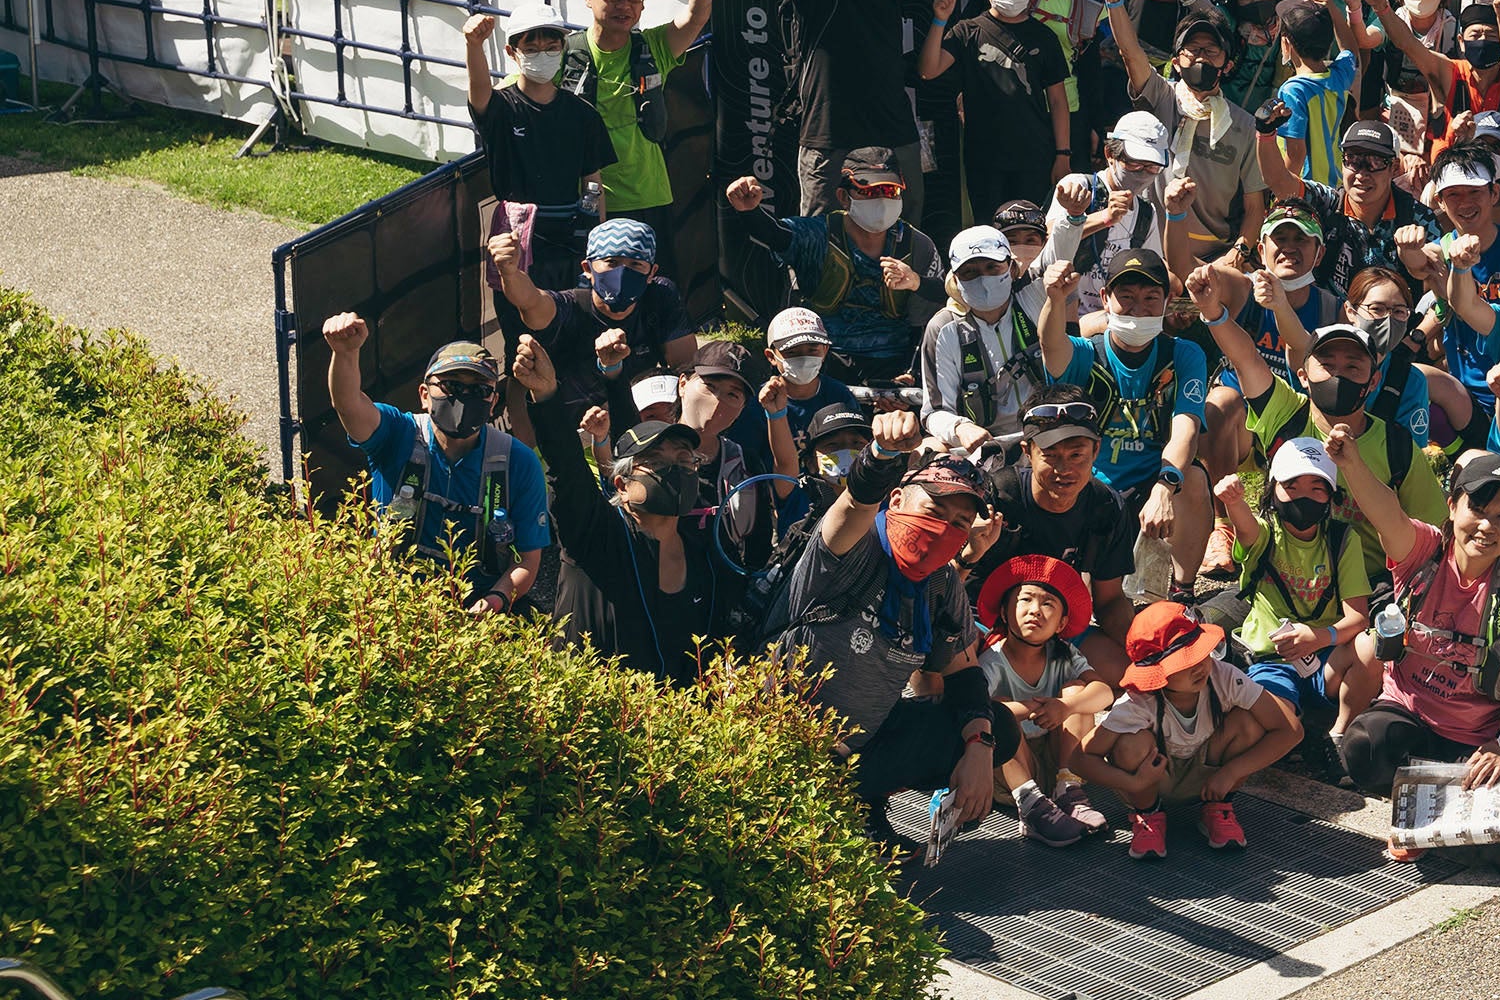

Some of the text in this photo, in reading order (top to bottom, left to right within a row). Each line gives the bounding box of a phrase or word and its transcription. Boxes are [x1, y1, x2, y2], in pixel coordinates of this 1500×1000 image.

[740, 6, 769, 46] to
[745, 57, 776, 213] venture
[1110, 437, 1145, 453] Club
[858, 635, 868, 648] 35
